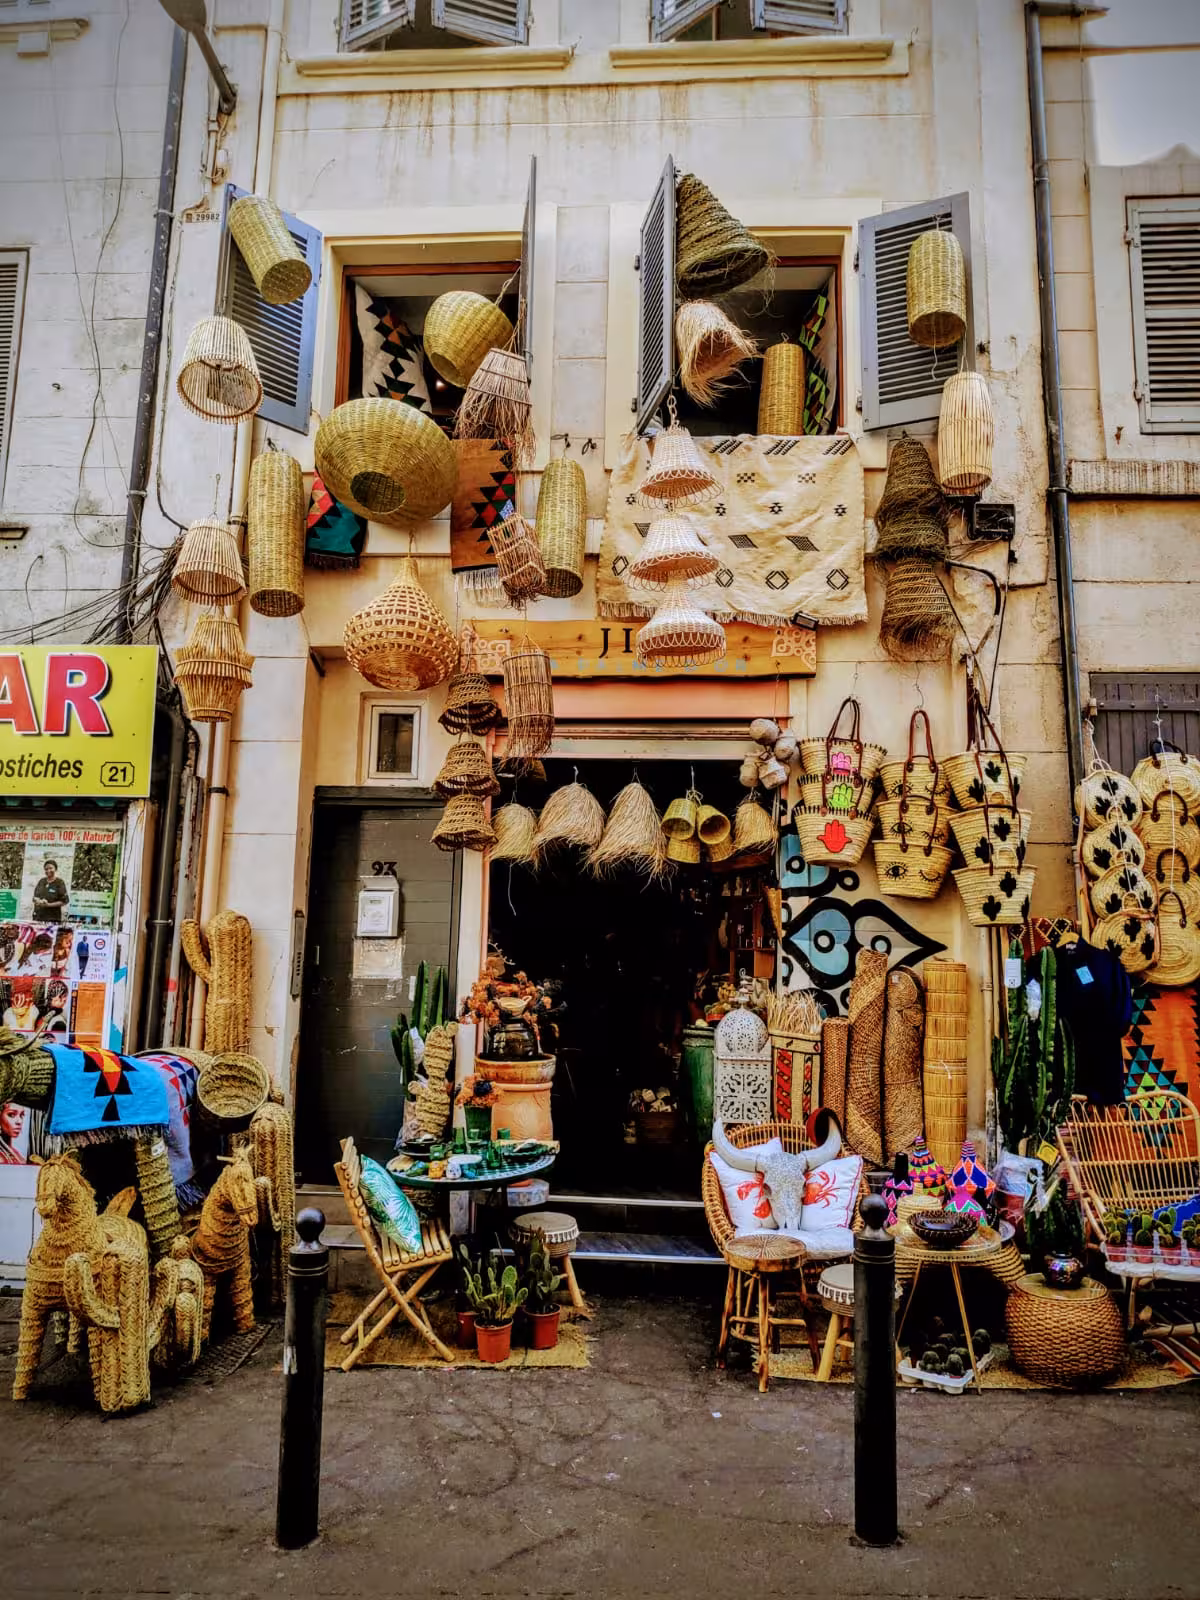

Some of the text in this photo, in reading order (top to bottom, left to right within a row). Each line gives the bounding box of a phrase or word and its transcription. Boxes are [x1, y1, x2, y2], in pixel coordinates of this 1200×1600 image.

[196, 213, 220, 221] 29982
[598, 627, 633, 659] JI
[108, 766, 127, 782] 21
[59, 830, 81, 842] 100%
[82, 831, 115, 843] Naturel
[371, 861, 398, 878] 93
